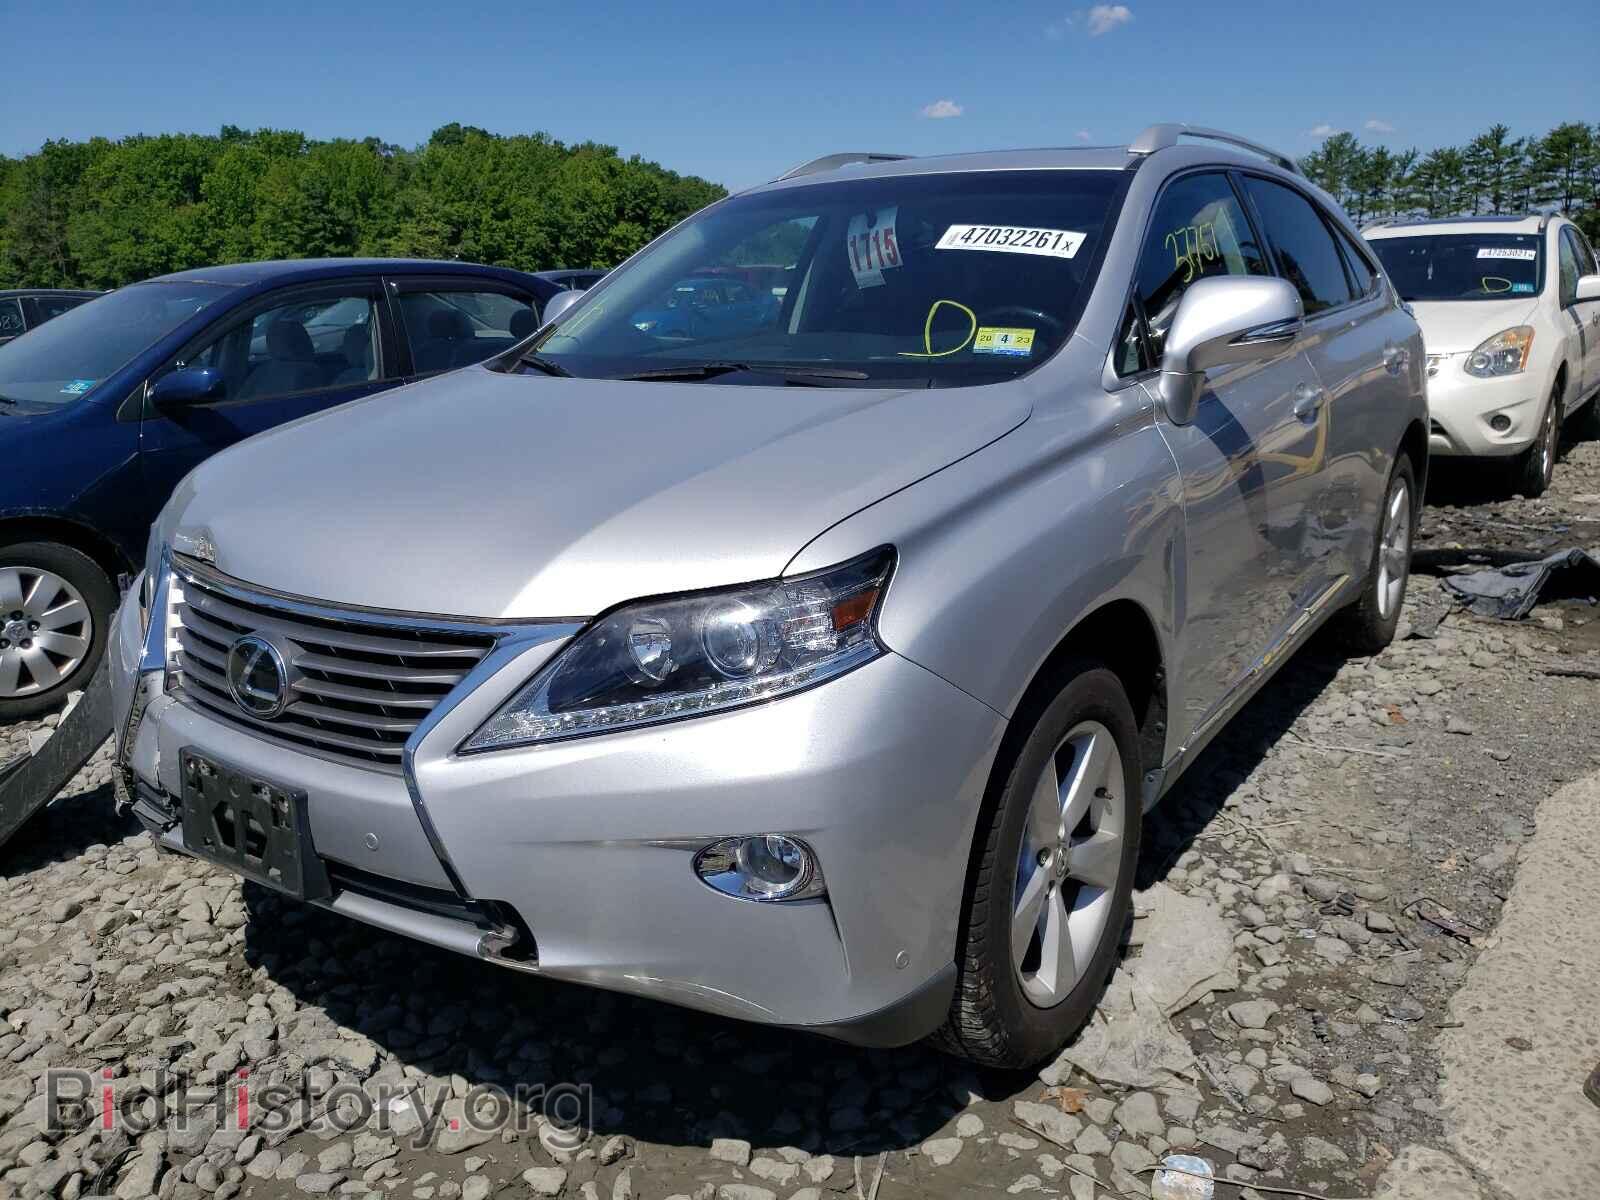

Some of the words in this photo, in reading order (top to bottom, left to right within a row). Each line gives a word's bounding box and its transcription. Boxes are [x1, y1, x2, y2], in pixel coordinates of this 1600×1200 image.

[849, 227, 898, 272] 1715
[1001, 334, 1009, 343] 4
[1016, 336, 1030, 344] 23
